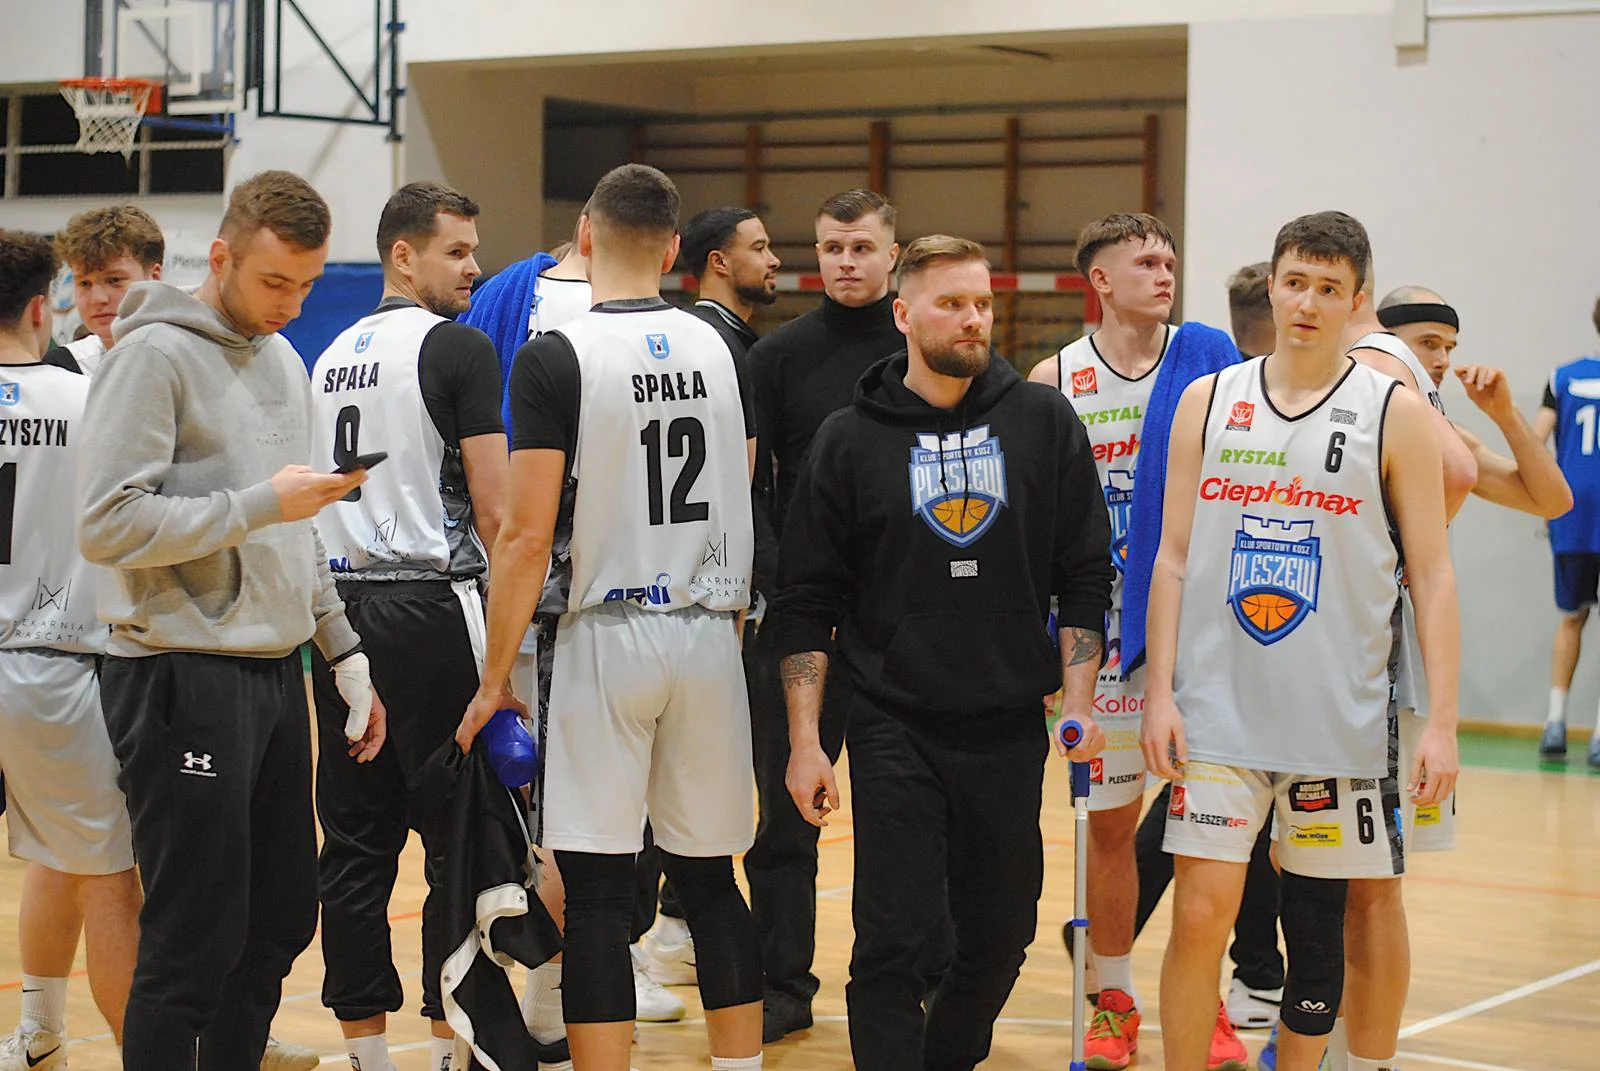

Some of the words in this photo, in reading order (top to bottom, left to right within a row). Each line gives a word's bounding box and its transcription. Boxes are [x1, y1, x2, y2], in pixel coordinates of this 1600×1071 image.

[324, 362, 380, 393] SPAŁA
[632, 371, 708, 403] SPAŁA
[640, 416, 709, 526] 12
[1219, 448, 1288, 467] RYSTAL
[1324, 431, 1346, 474] 6
[1199, 475, 1364, 516] Ciepłomax
[1292, 544, 1312, 555] KOSZ
[1230, 552, 1317, 602] PLESZEW
[1356, 797, 1375, 845] 6
